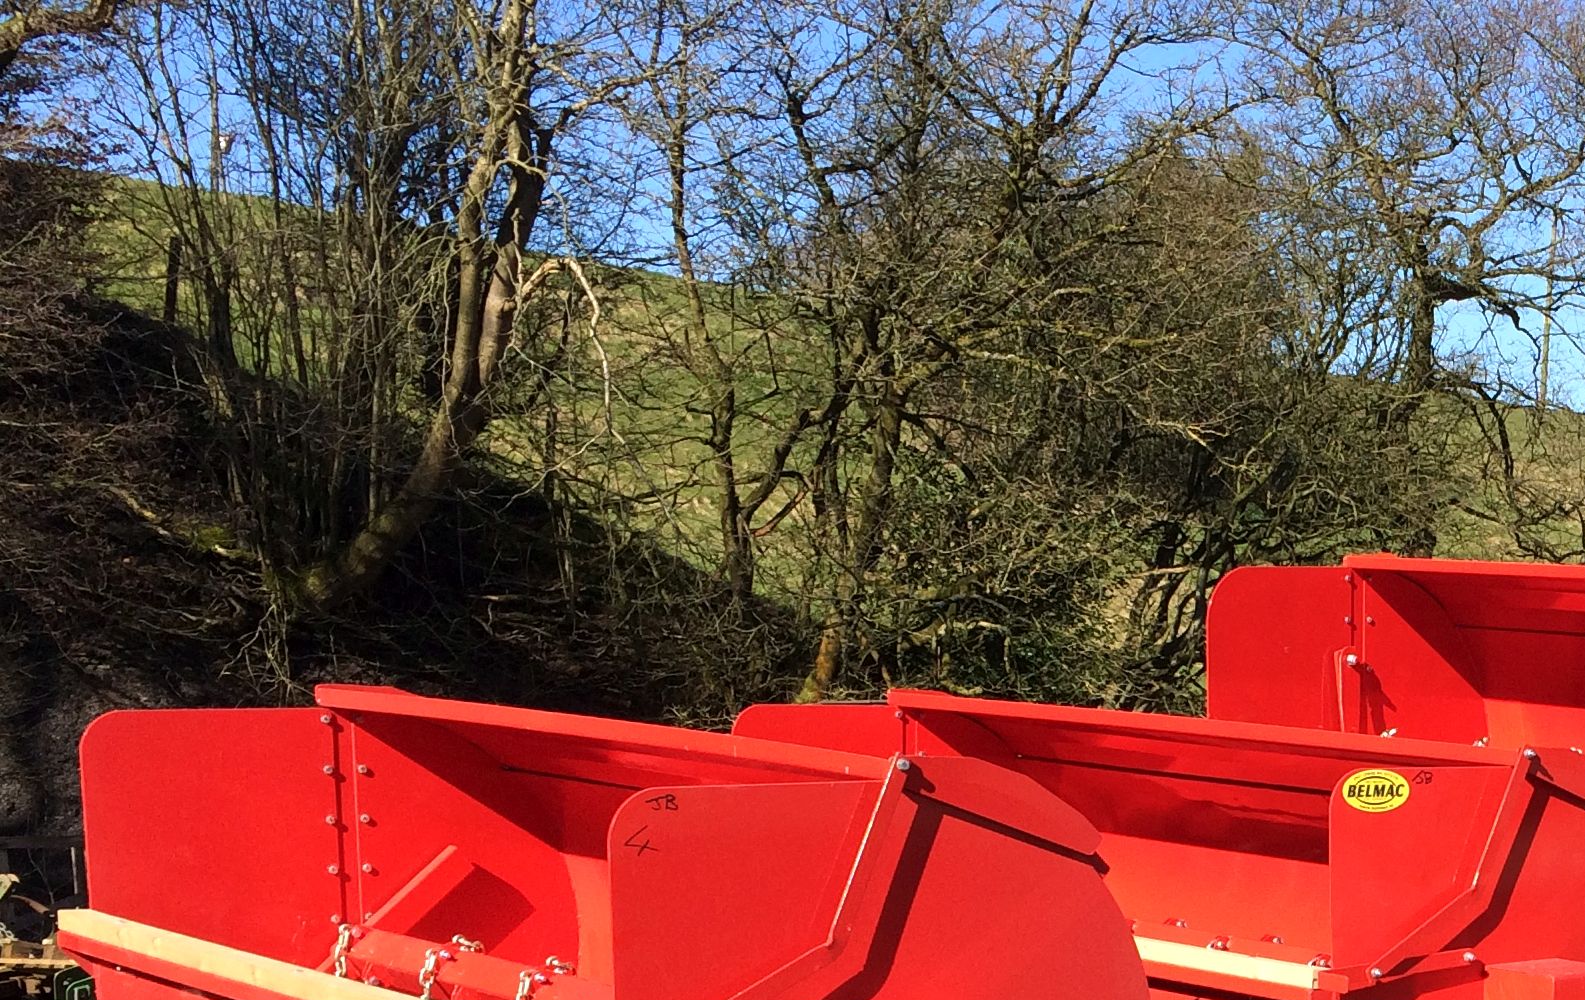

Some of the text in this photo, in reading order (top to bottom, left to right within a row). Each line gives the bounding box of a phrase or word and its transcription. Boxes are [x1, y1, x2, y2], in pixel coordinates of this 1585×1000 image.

[1347, 783, 1406, 798] BELMAC
[645, 793, 679, 811] JB
[624, 825, 659, 857] 4
